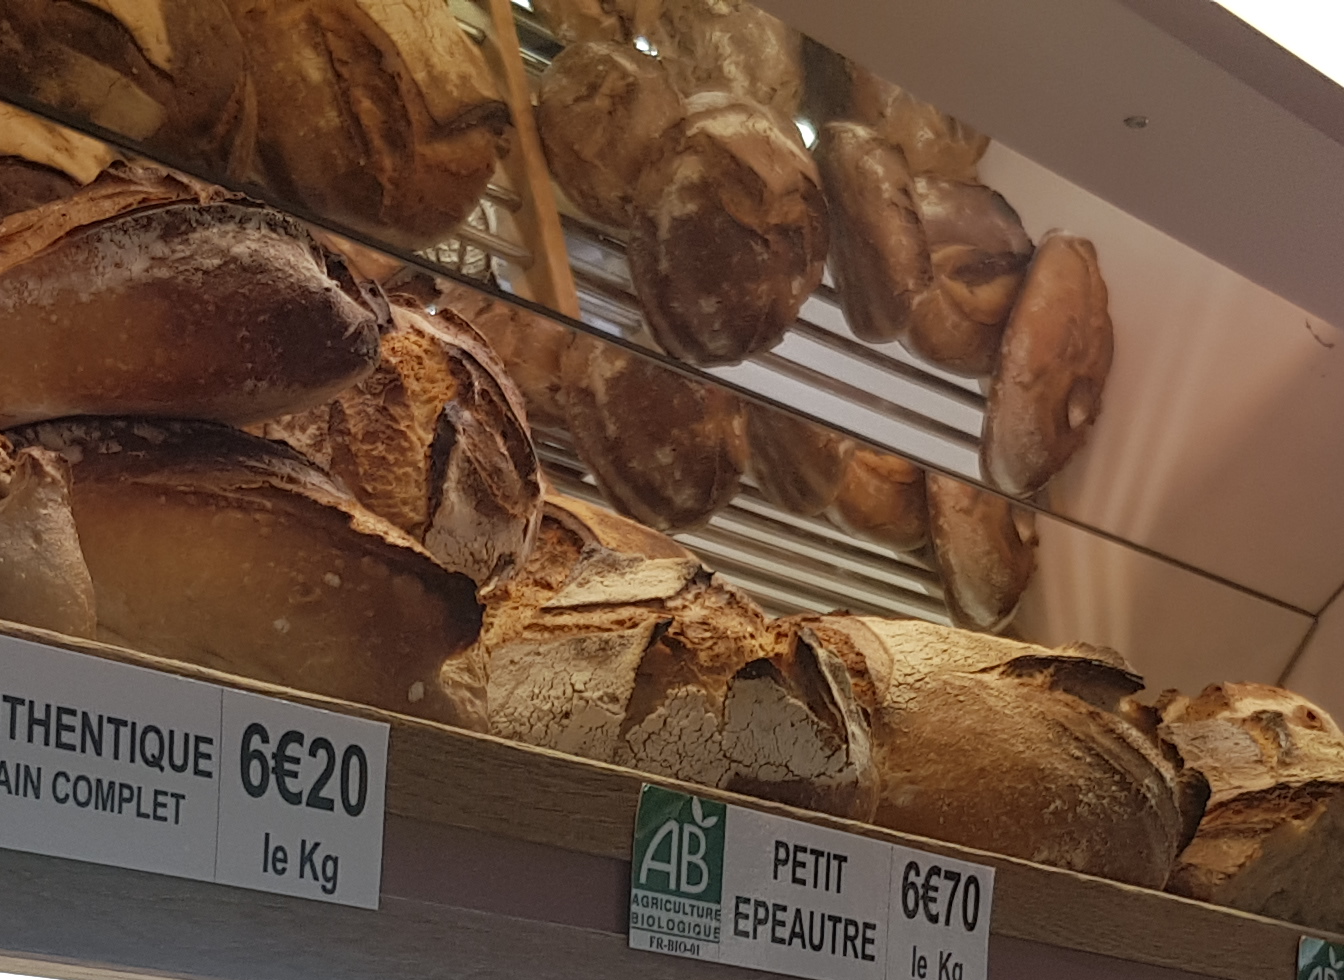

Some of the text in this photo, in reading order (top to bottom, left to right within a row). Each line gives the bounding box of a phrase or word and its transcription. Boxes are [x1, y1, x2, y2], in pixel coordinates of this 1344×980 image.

[52, 769, 186, 825] COMPLET
[240, 722, 368, 817] 6€20
[262, 832, 340, 895] le Kg
[639, 818, 709, 895] AB
[773, 839, 848, 894] PETIT
[632, 893, 721, 921] AGRICULTURE
[901, 859, 981, 932] 6€70
[631, 912, 721, 939] BIOLOGIQUE
[649, 935, 700, 956] FR-BIO-01
[733, 894, 877, 962] EPEAUTRE
[911, 944, 927, 979] le
